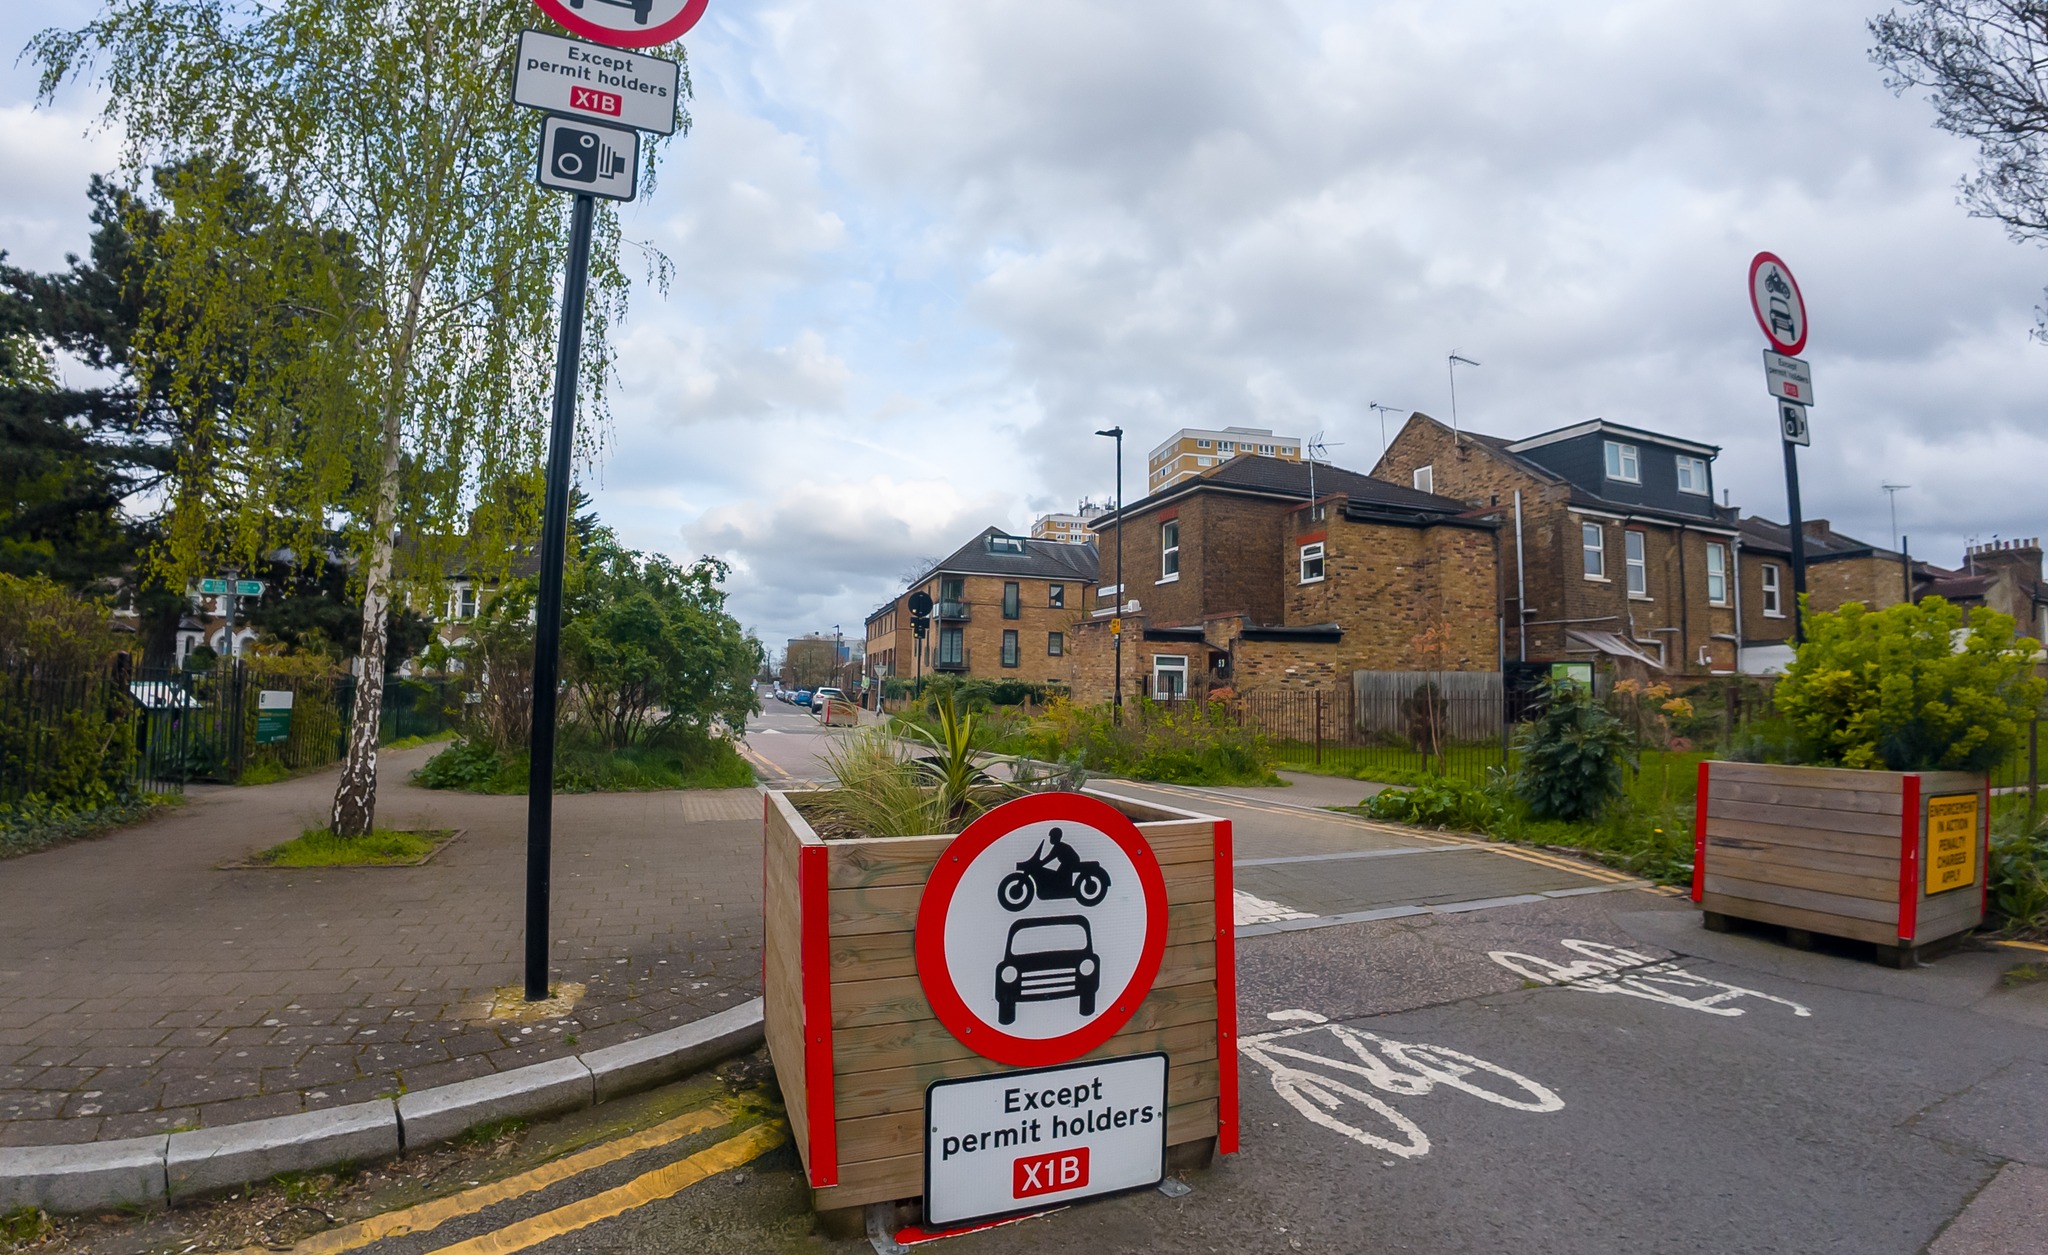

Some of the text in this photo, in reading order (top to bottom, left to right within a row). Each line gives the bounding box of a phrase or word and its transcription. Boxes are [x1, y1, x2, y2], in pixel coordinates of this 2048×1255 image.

[568, 46, 634, 73] Except
[527, 58, 668, 97] permit holders
[575, 90, 616, 113] X1B
[1769, 367, 1787, 377] permit
[1778, 358, 1797, 370] Except
[1930, 801, 1976, 817] ENFORCEMENT
[1937, 818, 1969, 832] IN ACTION
[1939, 836, 1966, 851] PENALTY
[1937, 852, 1967, 868] CHARGES
[1942, 869, 1961, 883] APPLY
[1004, 1077, 1103, 1114] Except
[942, 1105, 1154, 1161] permit holders
[1021, 1156, 1080, 1192] X1B
